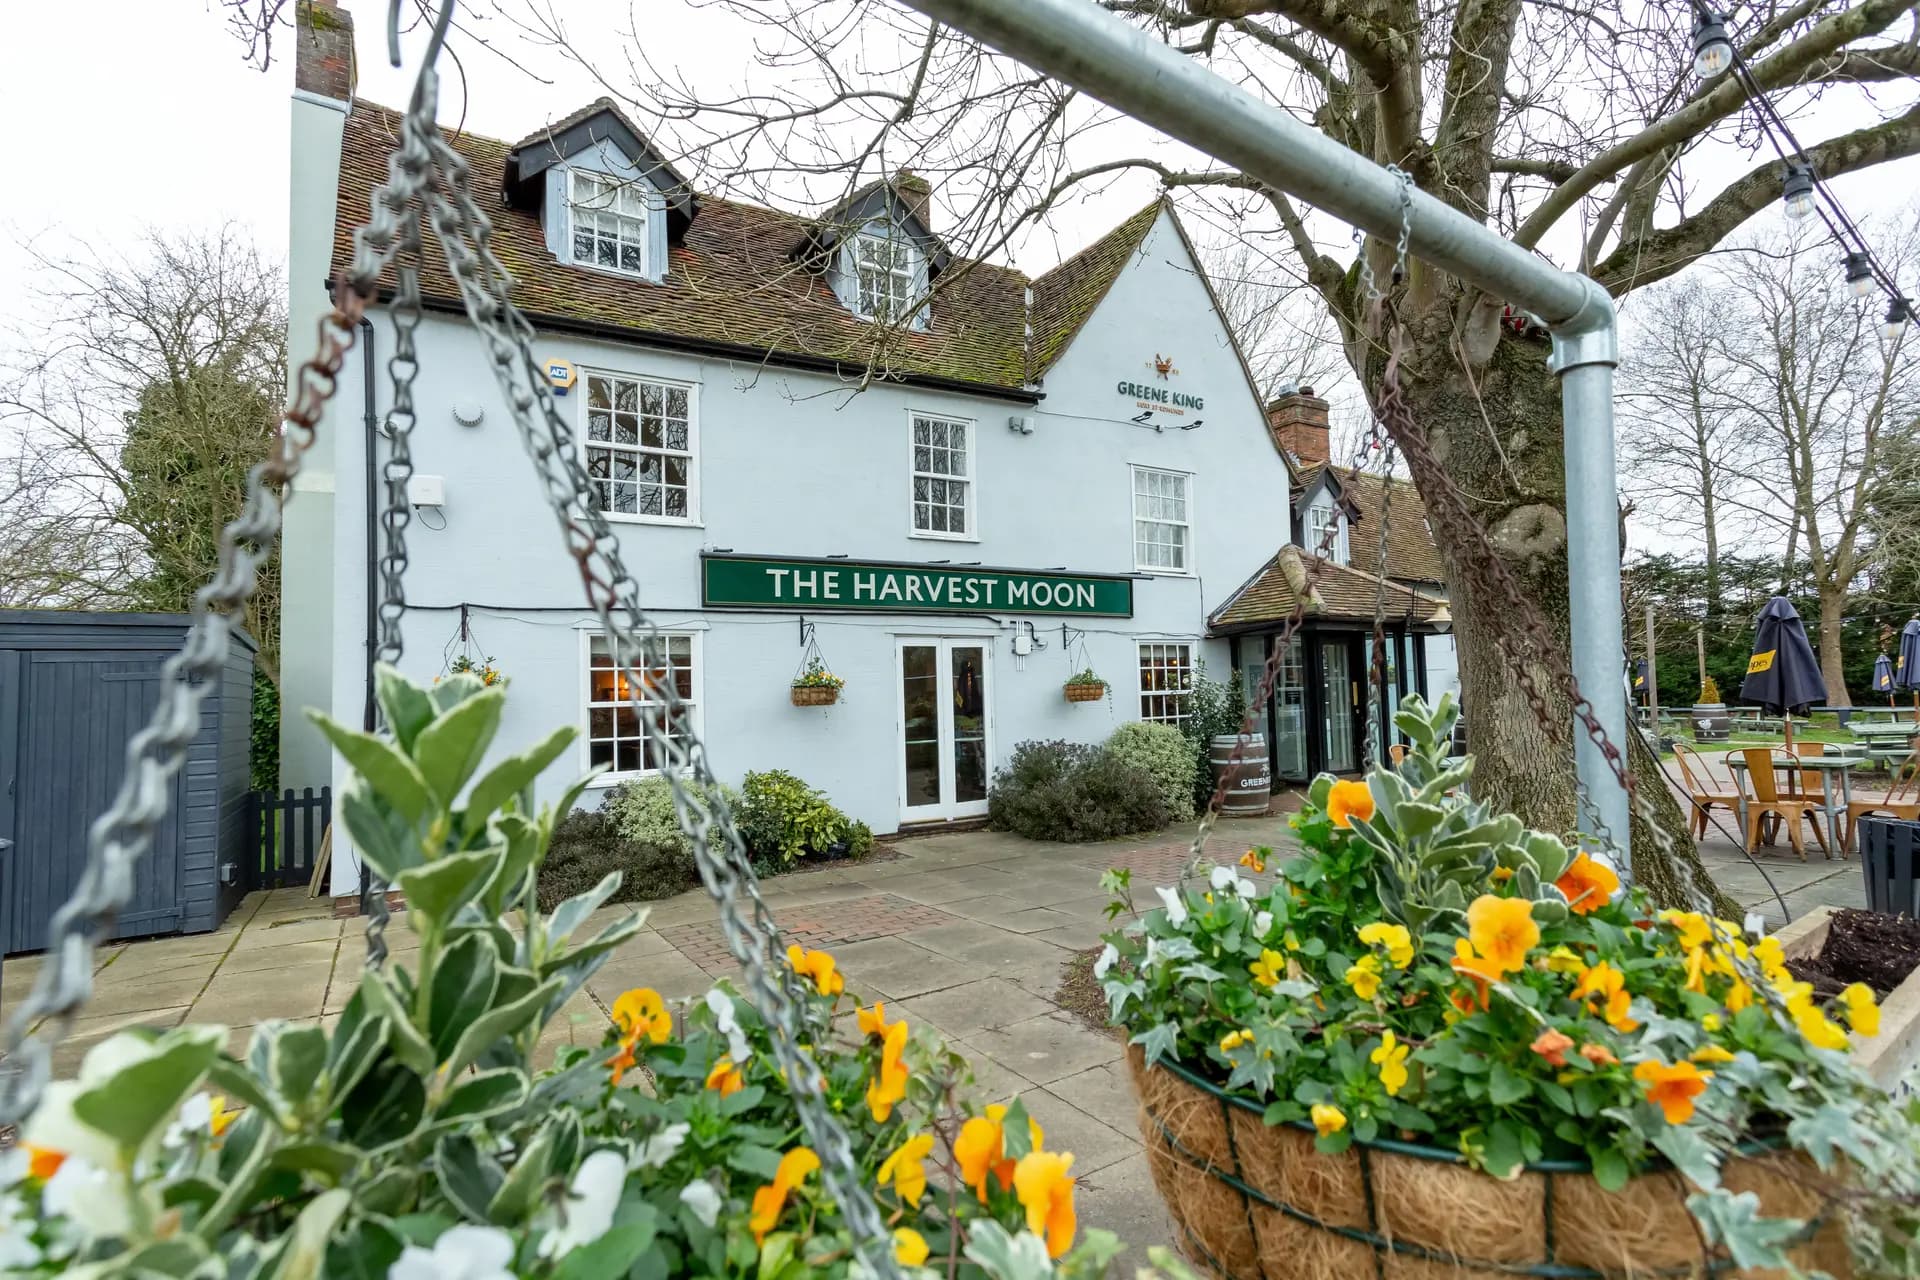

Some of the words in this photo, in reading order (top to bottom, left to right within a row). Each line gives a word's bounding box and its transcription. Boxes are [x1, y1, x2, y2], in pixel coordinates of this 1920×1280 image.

[551, 368, 567, 377] ADT
[1117, 381, 1168, 403] GREENE
[1172, 392, 1204, 410] KING
[765, 568, 840, 599] THE
[853, 572, 998, 605] HARVEST
[1007, 579, 1095, 608] MOON
